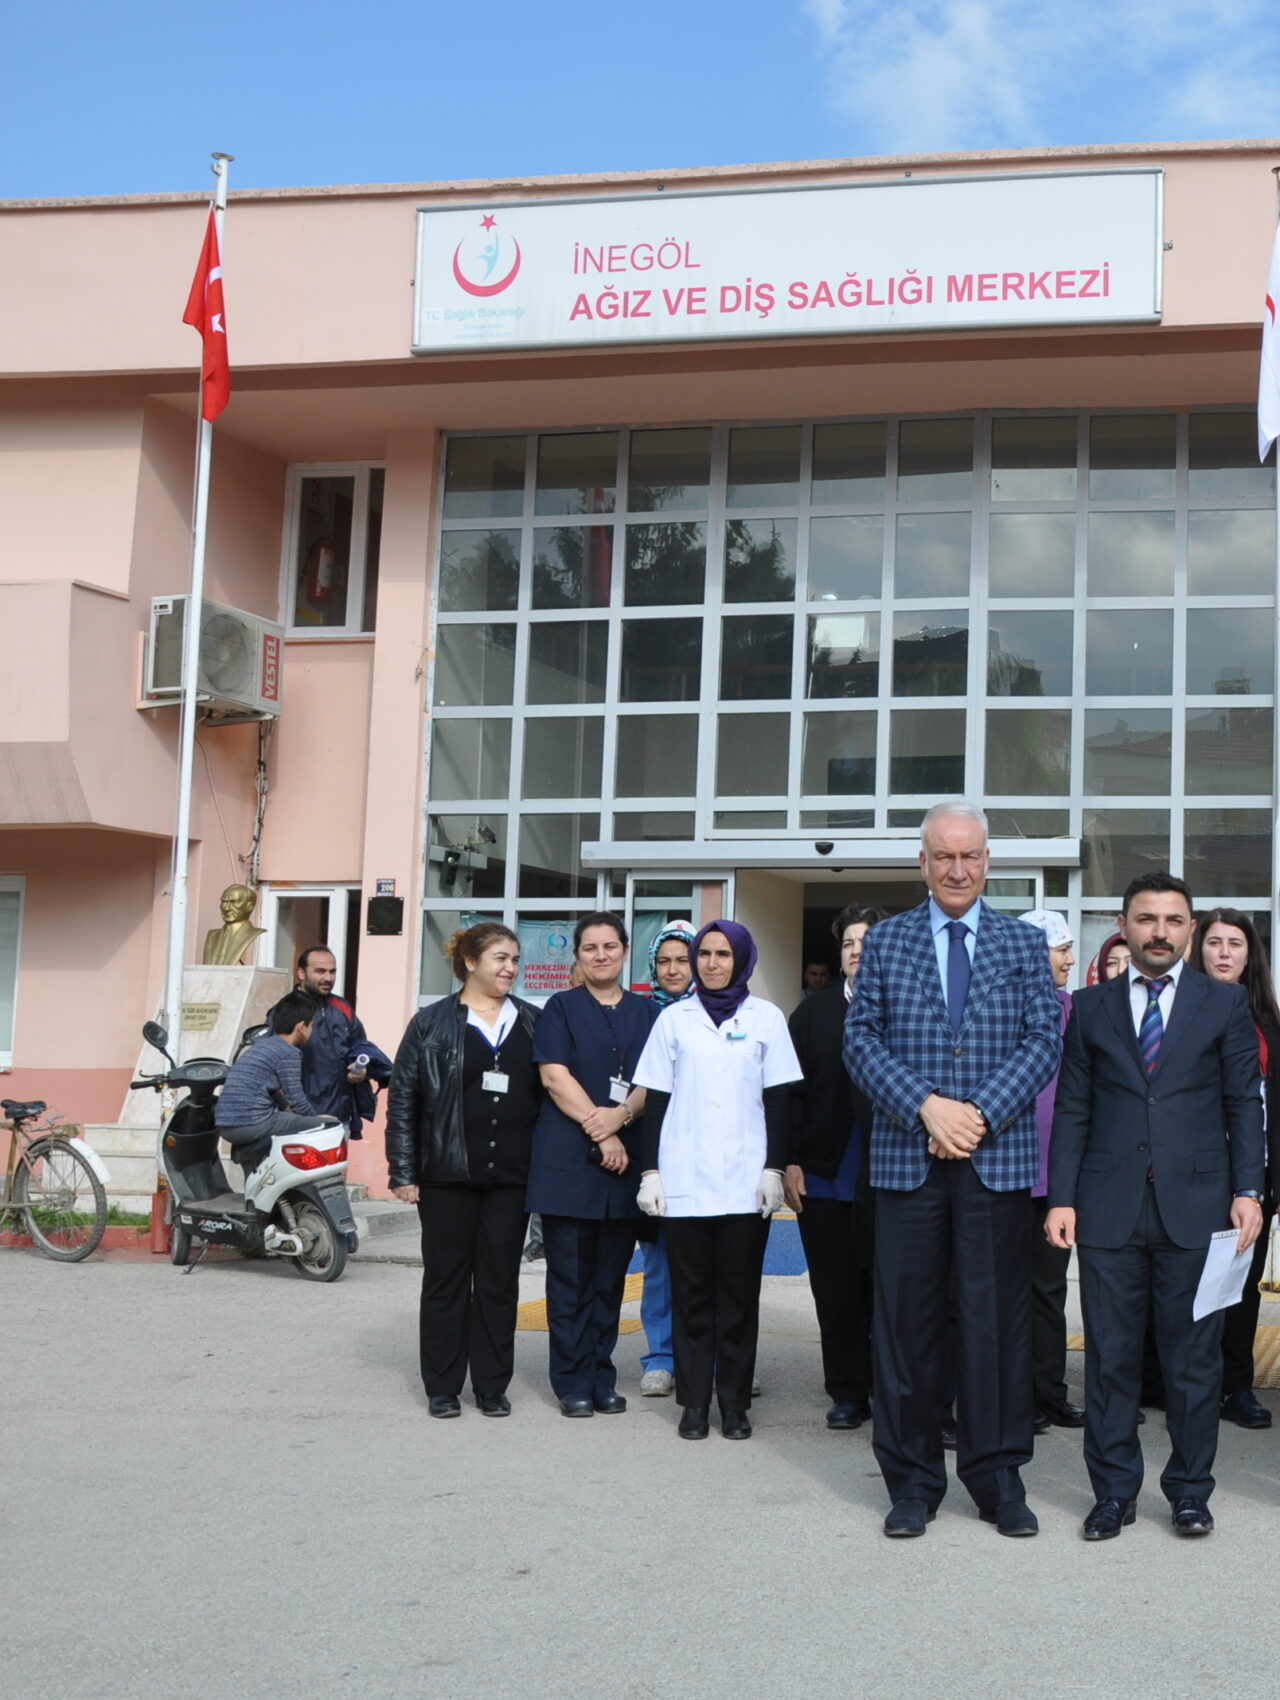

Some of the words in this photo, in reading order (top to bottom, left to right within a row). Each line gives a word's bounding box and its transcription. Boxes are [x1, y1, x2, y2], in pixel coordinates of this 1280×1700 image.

[573, 236, 701, 275] İNEGÖL
[569, 284, 652, 321] AĞIZ
[662, 286, 707, 317] VE
[719, 276, 776, 319] DİŞ
[787, 268, 933, 311] SAĞLIĞI
[946, 261, 1110, 304] MERKEZİ
[443, 308, 477, 322] Sağlık
[265, 638, 277, 697] VESTEL
[380, 883, 395, 892] 206
